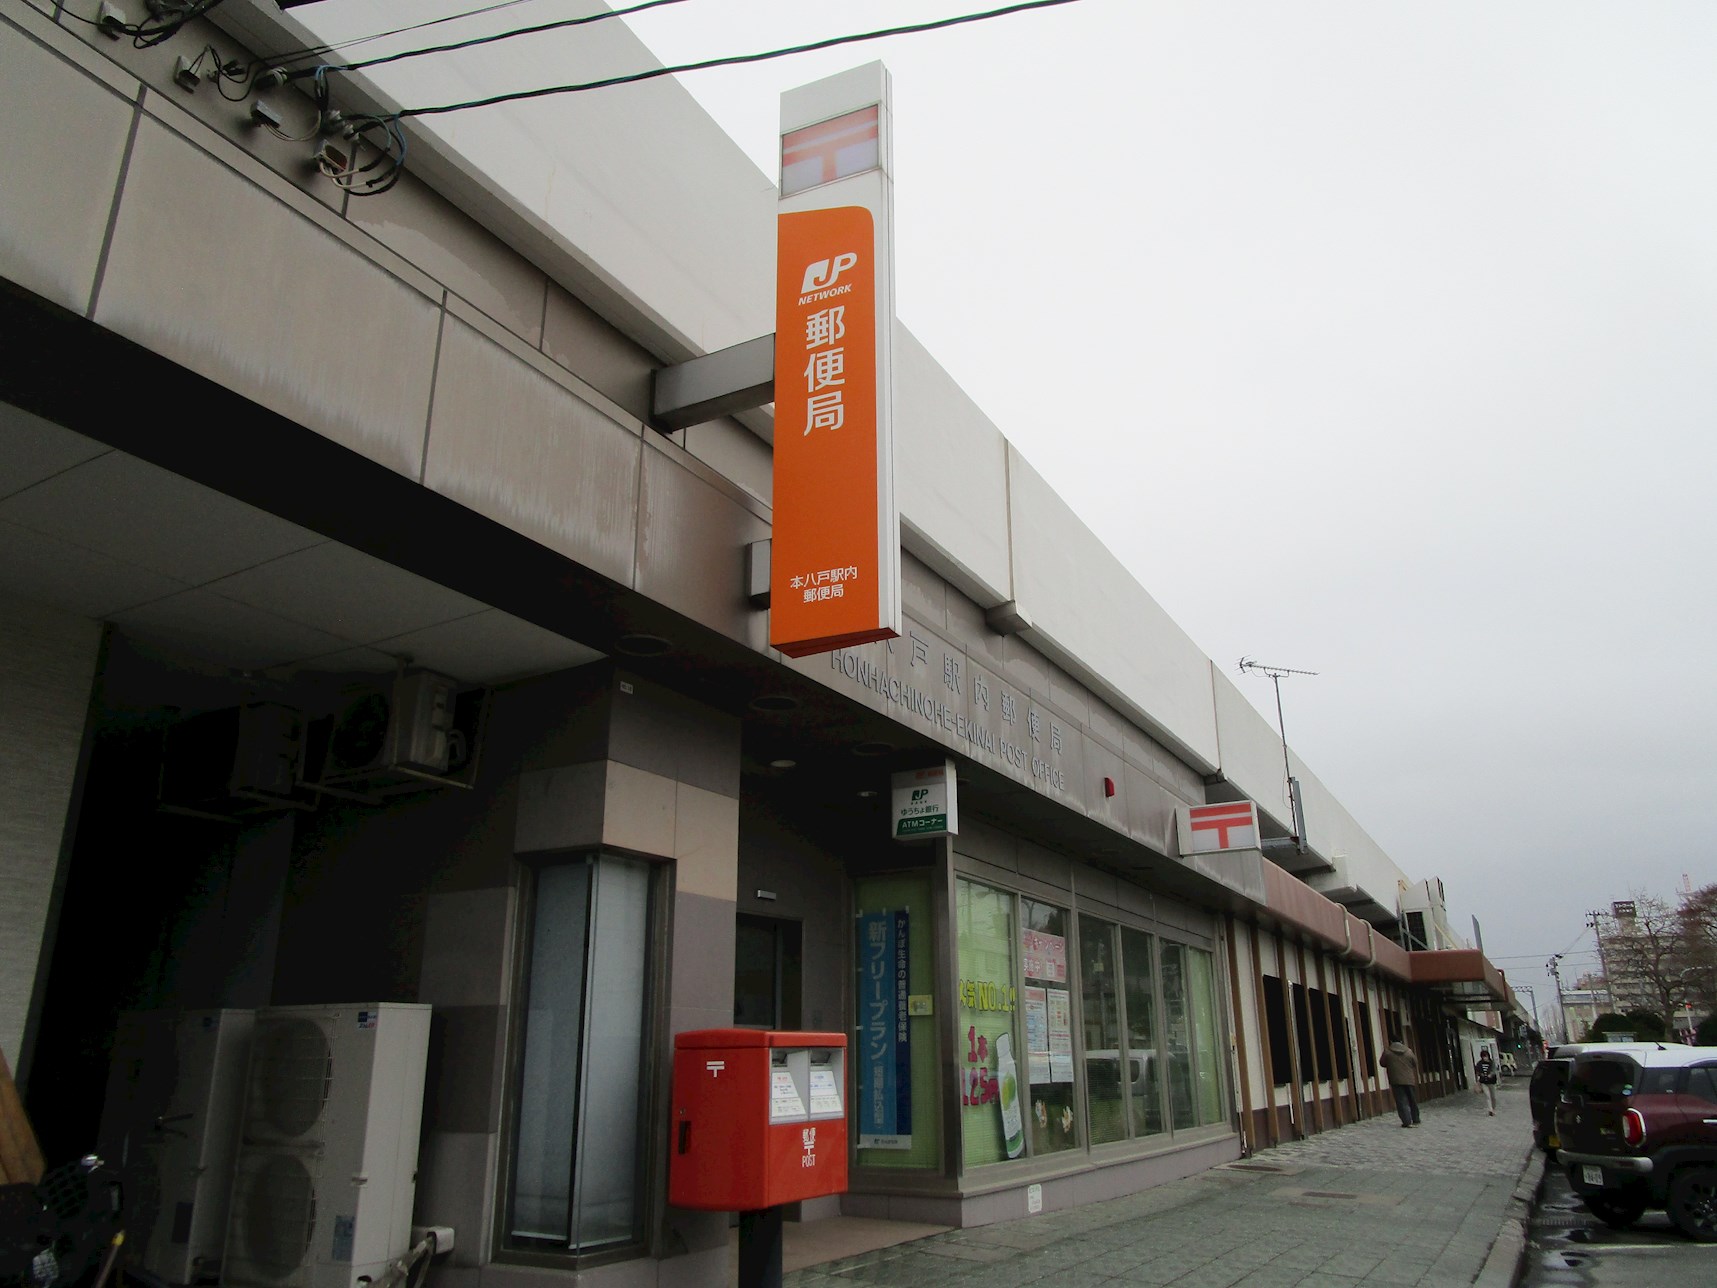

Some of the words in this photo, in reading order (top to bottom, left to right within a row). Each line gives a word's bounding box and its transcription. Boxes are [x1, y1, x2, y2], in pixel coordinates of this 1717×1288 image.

[798, 283, 853, 306] NETWORK
[803, 305, 846, 437] 郵便局
[789, 565, 859, 590] 本八戸駅内
[803, 583, 845, 604] 郵便局
[873, 630, 1063, 756] 戸駅内郵便局
[831, 648, 996, 755] HONHACHINOHE-EKINAI
[999, 737, 1028, 771] POST
[1031, 756, 1065, 791] OFFICE
[901, 804, 939, 816] ゆうちょ銀行
[901, 817, 943, 829] ATMコーナー
[803, 1127, 816, 1142] 郵便
[802, 1154, 816, 1168] POST
